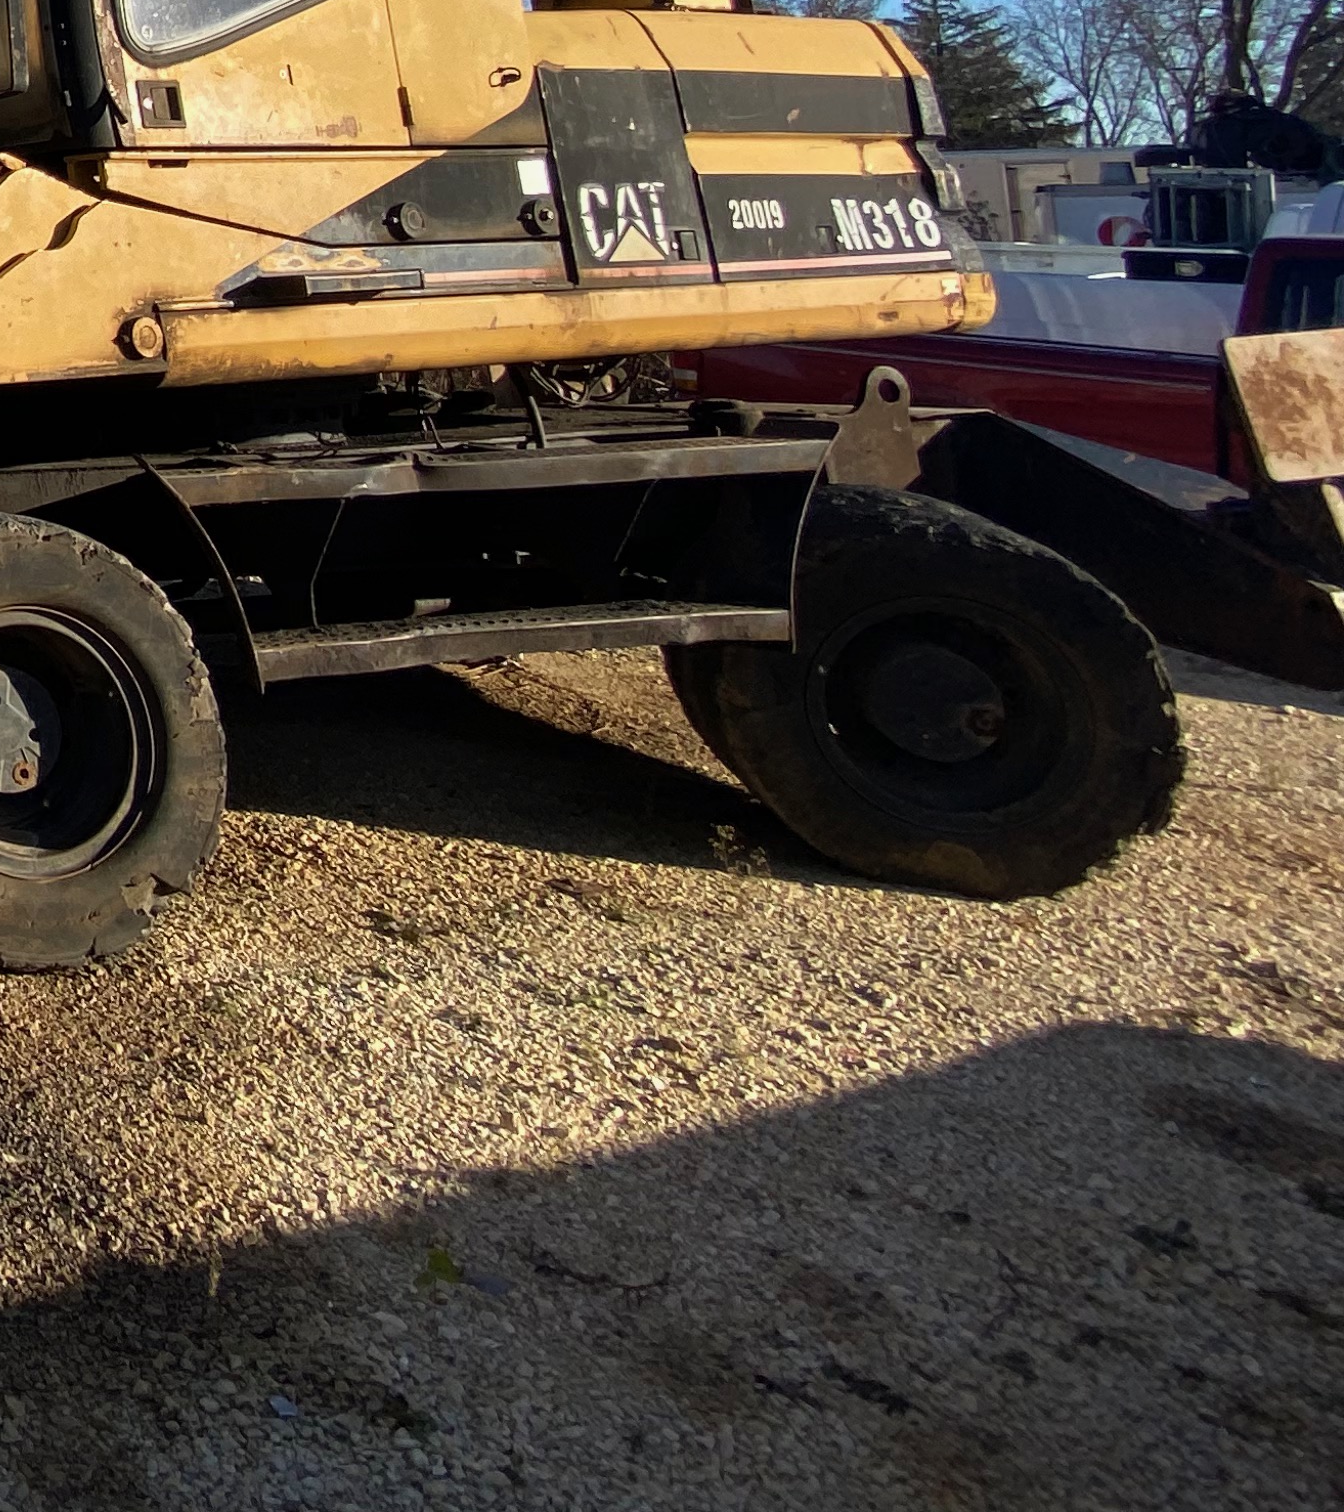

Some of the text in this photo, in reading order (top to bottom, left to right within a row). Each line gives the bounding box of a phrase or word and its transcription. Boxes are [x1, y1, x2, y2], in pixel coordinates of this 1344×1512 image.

[578, 182, 671, 259] CAT
[728, 198, 785, 229] 20019
[831, 197, 942, 251] M318
